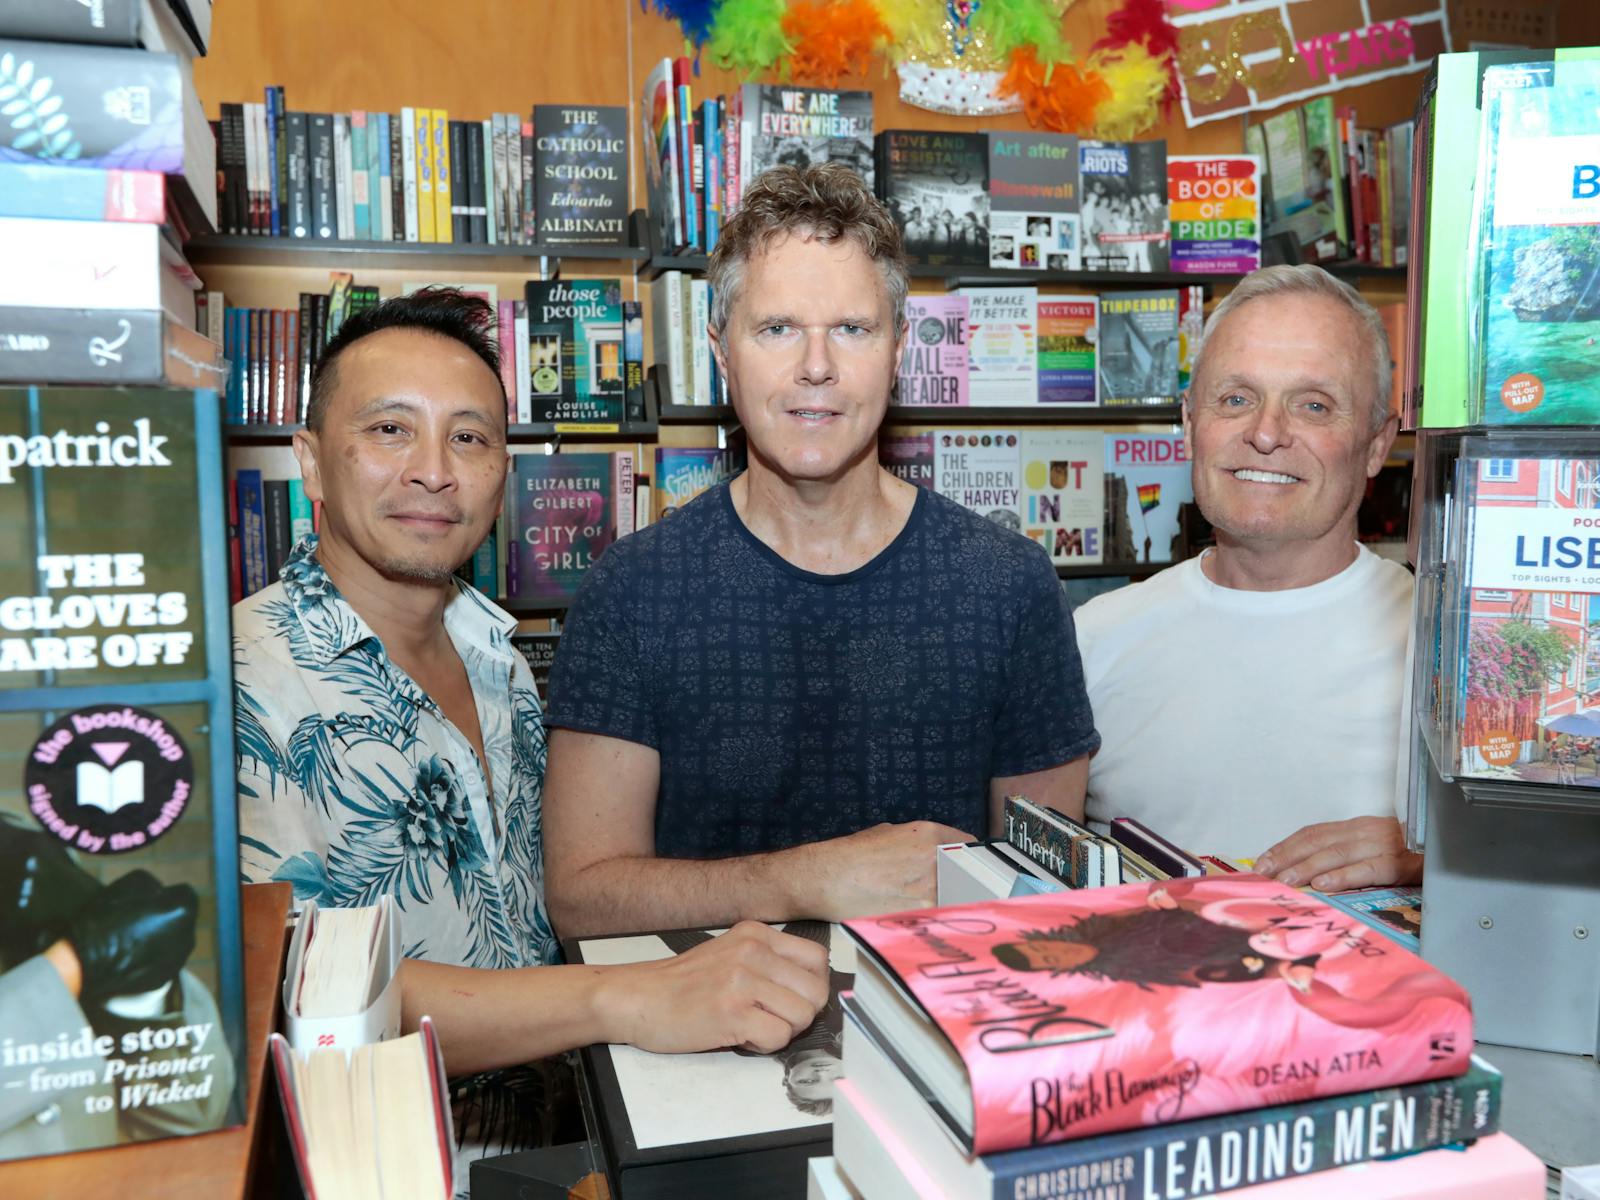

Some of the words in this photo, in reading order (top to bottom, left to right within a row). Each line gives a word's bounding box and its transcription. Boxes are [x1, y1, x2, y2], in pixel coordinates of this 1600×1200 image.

[1296, 18, 1415, 81] YEARS
[782, 91, 804, 112] WE
[808, 92, 840, 114] ARE
[562, 110, 598, 126] THE
[761, 112, 858, 138] EVERYWHERE
[537, 136, 624, 153] CATHOLIC
[891, 136, 928, 148] LOVE
[932, 137, 965, 149] AND
[994, 140, 1021, 157] Art
[1027, 143, 1069, 160] after
[890, 150, 981, 164] RESISTANCE
[1085, 156, 1128, 173] RIOTS
[544, 165, 618, 181] SCHOOL
[1195, 162, 1228, 177] THE
[1178, 180, 1247, 200] BOOK
[550, 192, 613, 208] Edoardo
[1200, 203, 1225, 218] OF
[541, 218, 623, 233] ALBINATI
[1178, 221, 1246, 239] PRIDE
[549, 284, 600, 302] those
[972, 296, 989, 306] WE
[992, 295, 1025, 306] MAKE
[543, 302, 607, 322] people
[908, 302, 927, 316] he
[970, 308, 980, 318] IT
[984, 308, 1028, 319] BETTER
[1040, 306, 1092, 315] VICTORY
[1101, 298, 1175, 314] TINDERBOX
[910, 318, 965, 345] TONE
[901, 347, 943, 375] WALL
[901, 376, 959, 404] READER
[1504, 385, 1539, 398] PULL-OUT
[1511, 380, 1531, 389] WITH
[556, 402, 596, 411] LOUISE
[1511, 393, 1536, 405] MAP
[545, 411, 608, 419] CANDLISH
[0, 417, 172, 483] patrick
[1114, 439, 1188, 464] PRIDE
[942, 454, 968, 470] THE
[620, 457, 632, 494] PETER
[942, 472, 1014, 488] CHILDREN
[1025, 460, 1088, 490] OUT
[527, 478, 600, 491] ELIZABETH
[533, 497, 593, 510] GILBERT
[964, 490, 1019, 506] HARVEY
[1028, 495, 1060, 524] IN
[525, 526, 578, 545] CITY
[583, 527, 602, 537] OF
[1027, 528, 1099, 557] TIME
[37, 554, 145, 588] THE
[1512, 574, 1531, 582] TOP
[1534, 575, 1571, 584] SIGHTS
[0, 592, 188, 630] GLOVES
[0, 635, 98, 672] ARE
[102, 632, 193, 667] OFF
[33, 728, 73, 764] the
[71, 708, 184, 762] bookshop
[1488, 736, 1508, 745] WITH
[1482, 742, 1516, 752] PULL-OUT
[1489, 749, 1512, 759] MAP
[29, 783, 79, 841] signed
[77, 830, 105, 853] by
[109, 831, 146, 851] the
[148, 779, 190, 836] author
[3, 1026, 116, 1067] inside
[121, 1022, 213, 1054] story
[30, 1066, 96, 1092] from
[102, 1054, 215, 1084] Prisoner
[1253, 1058, 1320, 1087] DEAN
[1328, 1049, 1383, 1075] ATTA
[85, 1095, 114, 1114] to
[120, 1074, 214, 1110] Wicked
[1031, 1072, 1102, 1146] Black
[1104, 1058, 1201, 1124] Flamingo
[1144, 1116, 1315, 1200] LEADING
[1333, 1096, 1417, 1165] MEN
[1015, 1156, 1135, 1200] CHRISTOPHER
